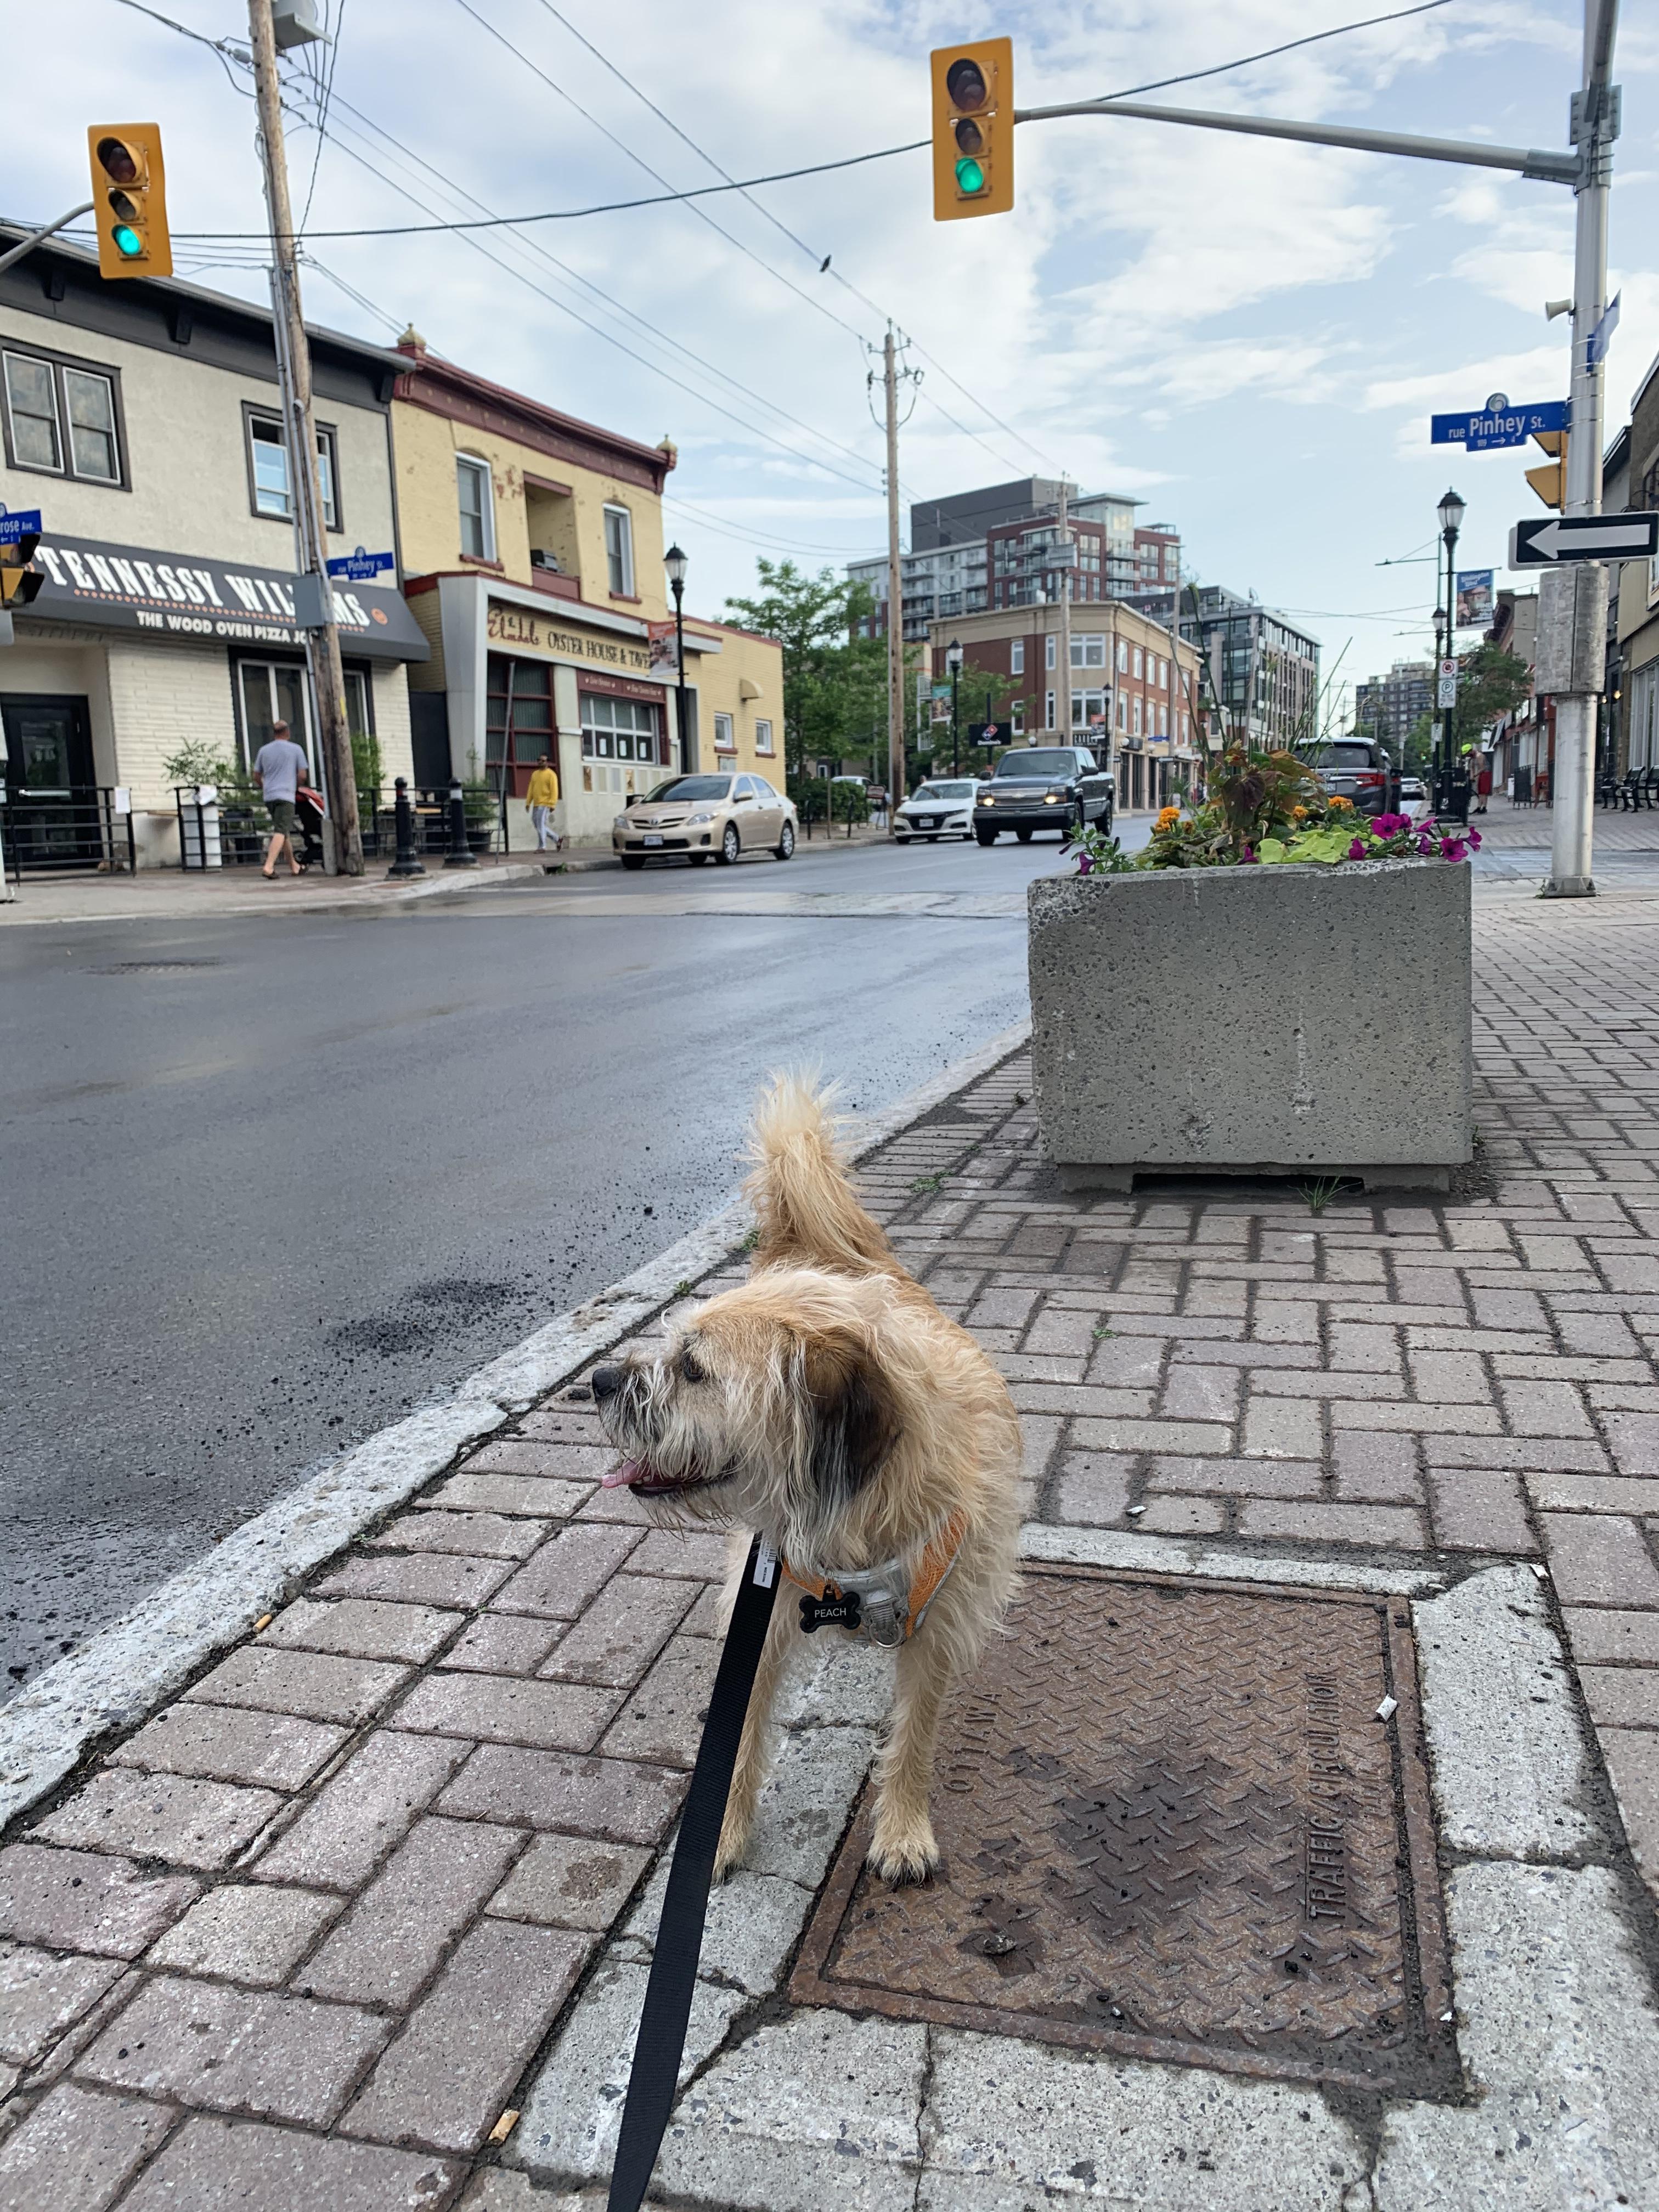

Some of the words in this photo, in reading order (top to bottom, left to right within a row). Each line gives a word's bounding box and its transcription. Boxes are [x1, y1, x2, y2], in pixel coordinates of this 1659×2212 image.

[1448, 428, 1465, 439] rue
[1469, 413, 1526, 437] Pinhey
[1531, 416, 1546, 429] St.
[347, 558, 375, 573] Pinhey
[34, 545, 224, 607] TENNESSY
[224, 574, 370, 627] WILMS
[136, 610, 163, 628] THE
[167, 614, 213, 634] WOOD
[216, 620, 253, 639] OVEN
[254, 625, 291, 643] PIZZA
[548, 631, 584, 656] OYSTER
[586, 640, 618, 663] HOUSE
[620, 648, 627, 664] &
[629, 650, 651, 669] TAVE
[815, 1607, 847, 1618] PEACH
